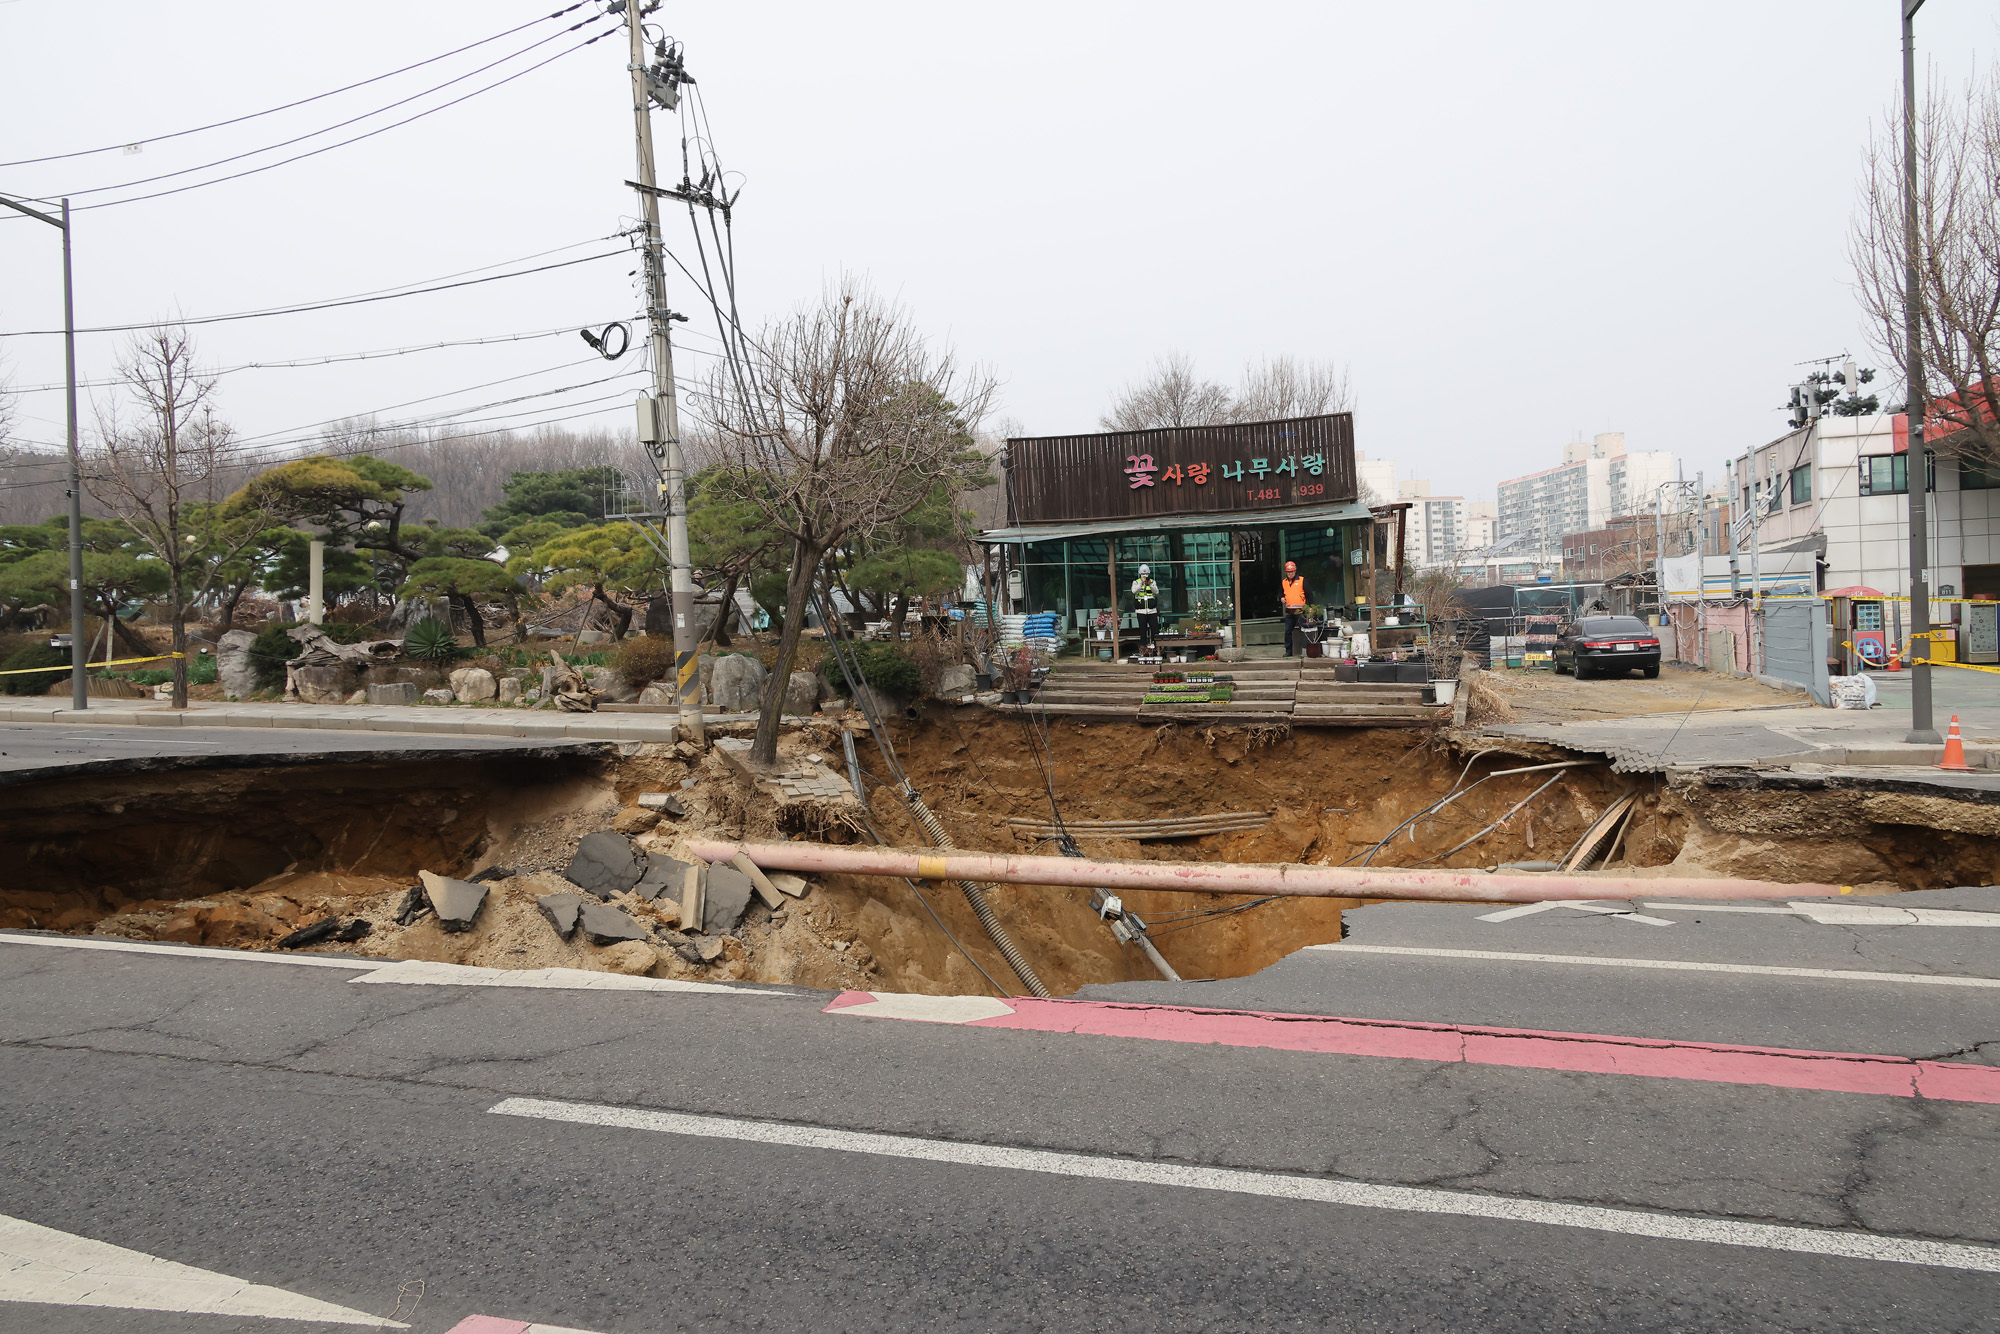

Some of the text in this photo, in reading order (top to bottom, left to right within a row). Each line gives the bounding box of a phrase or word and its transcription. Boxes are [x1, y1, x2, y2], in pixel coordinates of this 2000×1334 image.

[1124, 453, 1326, 489] 꽃사랑 나무사랑
[1247, 483, 1324, 501] T.481 939
